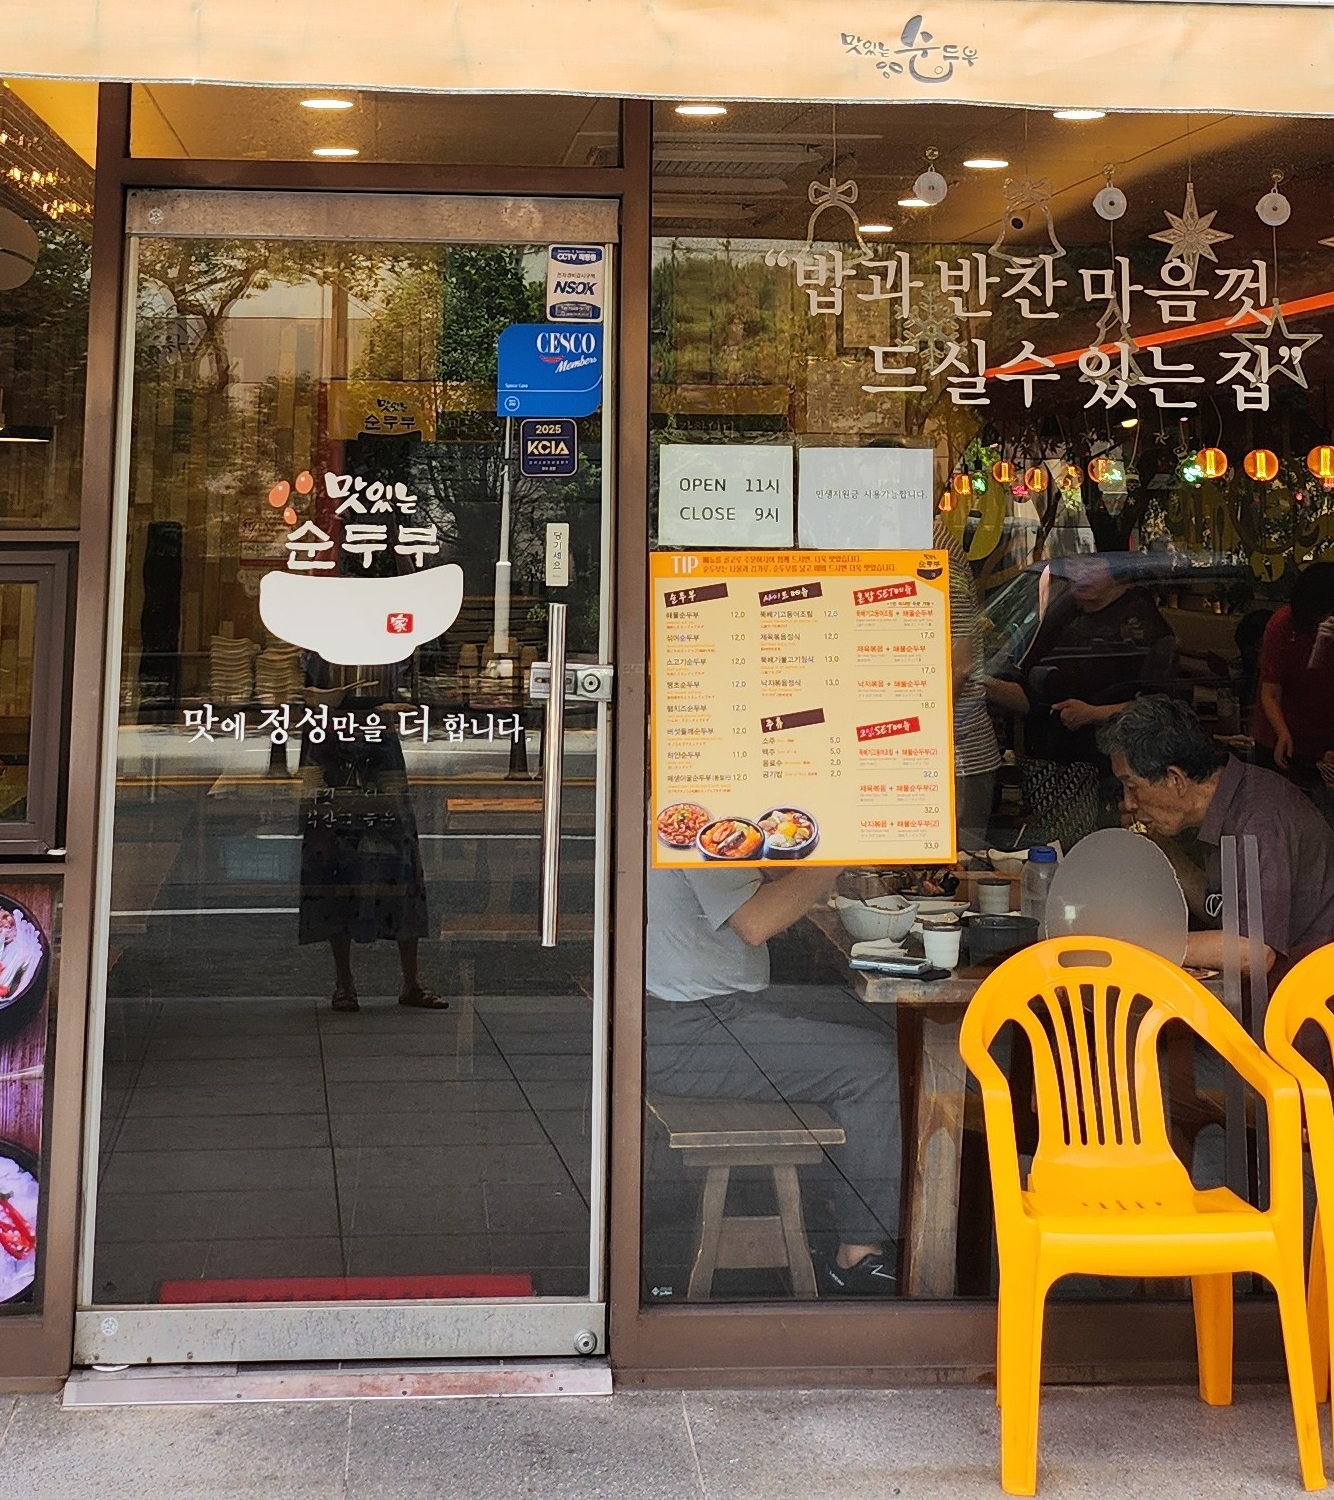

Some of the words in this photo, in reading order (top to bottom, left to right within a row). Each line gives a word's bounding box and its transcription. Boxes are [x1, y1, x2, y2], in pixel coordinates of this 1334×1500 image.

[553, 280, 597, 295] NSOK
[934, 250, 1067, 320] 반찬
[1078, 255, 1269, 326] 마음껏
[536, 332, 595, 354] CESCO
[554, 354, 597, 374] Members
[1078, 344, 1205, 411] 있는
[364, 413, 416, 430] 순두부
[535, 424, 562, 434] 2025
[527, 440, 570, 455] KCIA
[324, 472, 418, 514] 맛있는
[679, 478, 727, 492] OPEN
[745, 478, 779, 494] 11시
[679, 506, 736, 521] CLOSE
[754, 507, 779, 522] 9시
[285, 520, 440, 570] 순두부
[552, 531, 563, 570] 당기세요
[671, 556, 699, 574] TIP
[390, 613, 410, 633] 家
[182, 703, 247, 744] 맛에
[257, 703, 387, 744] 정성만을
[398, 704, 431, 744] 더
